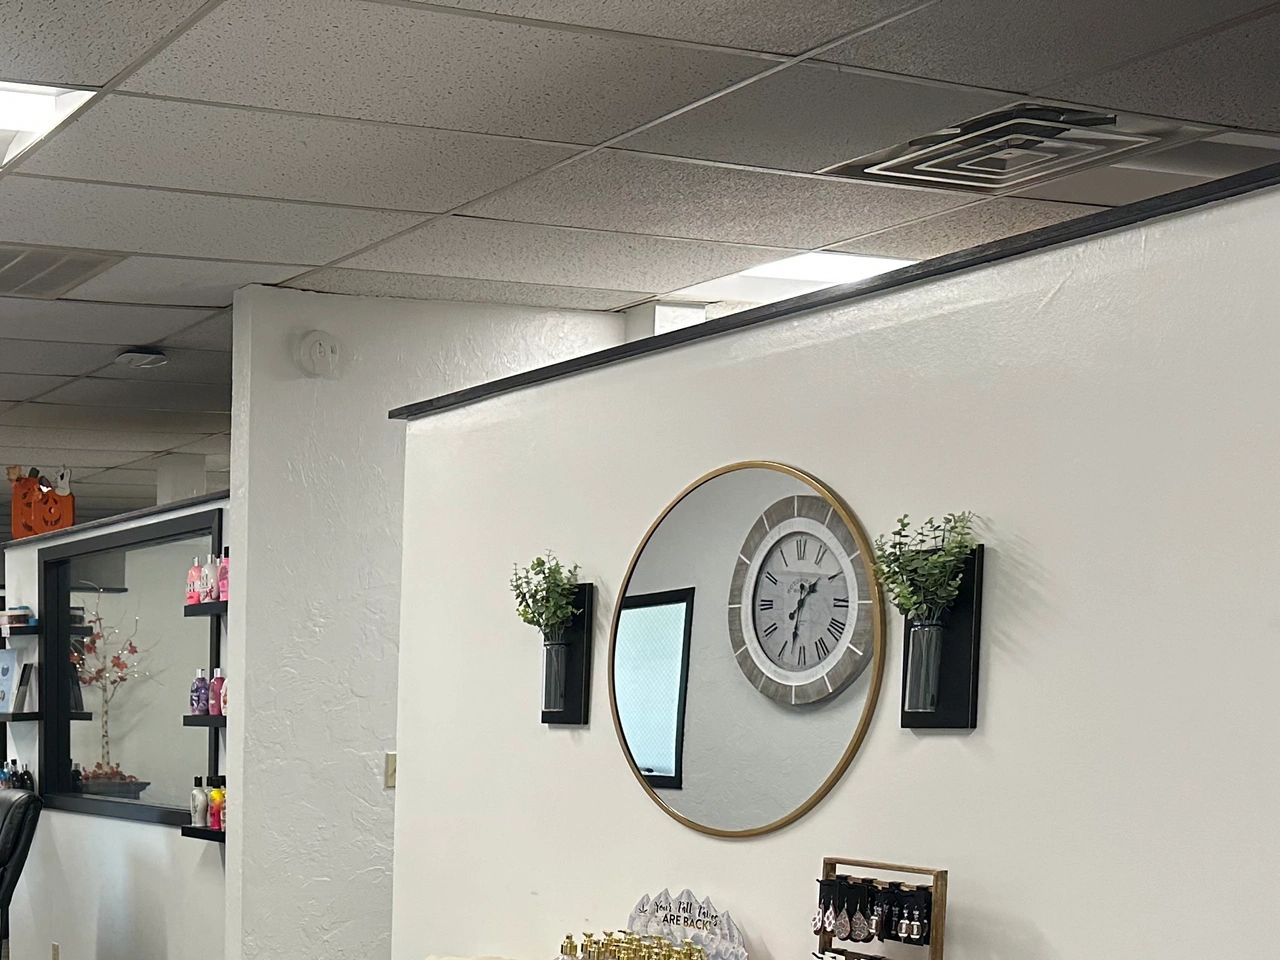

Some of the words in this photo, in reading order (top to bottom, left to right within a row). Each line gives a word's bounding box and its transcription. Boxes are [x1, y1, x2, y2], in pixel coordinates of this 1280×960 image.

[654, 900, 672, 914] Your
[678, 901, 693, 914] Fall
[662, 914, 681, 926] ARE
[683, 917, 711, 931] BACK!
